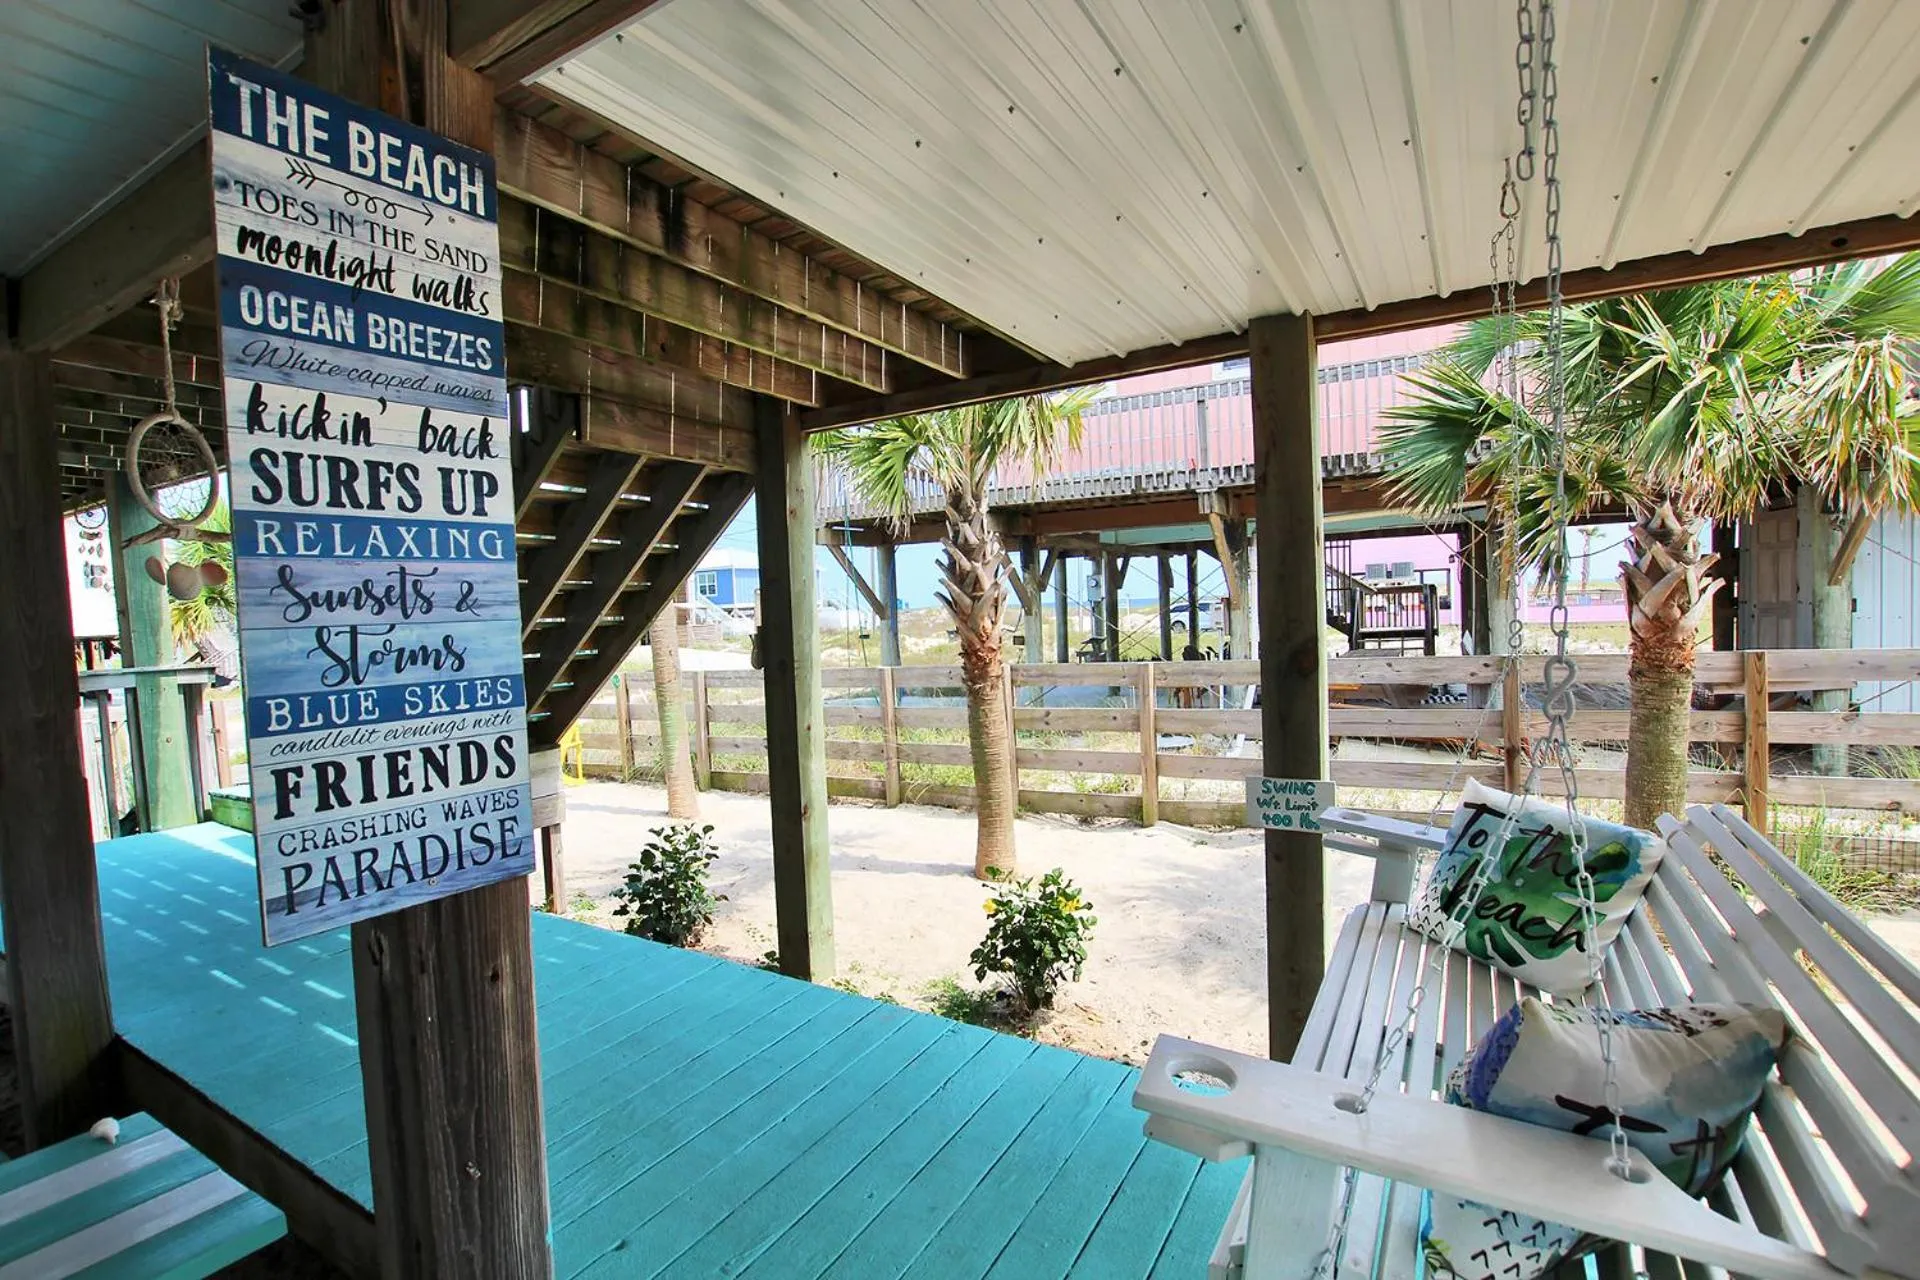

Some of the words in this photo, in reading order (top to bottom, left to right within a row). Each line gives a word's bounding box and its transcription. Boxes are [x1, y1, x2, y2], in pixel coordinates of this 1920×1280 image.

[229, 72, 330, 164] THE
[348, 120, 485, 215] BEACH
[234, 180, 319, 226] TOES
[328, 208, 355, 237] IN
[365, 220, 416, 254] THE
[425, 239, 488, 274] SAND
[237, 225, 396, 302] moonlight
[412, 273, 490, 316] walks
[240, 285, 355, 344] OCEAN
[367, 312, 492, 371] BREEZES
[347, 365, 431, 392] capped
[434, 381, 494, 401] waves
[418, 407, 499, 460] back
[250, 447, 422, 513] SURFS
[437, 467, 499, 516] UP
[254, 520, 504, 560] RELAXING
[269, 564, 439, 623] Sunsets
[455, 580, 480, 617] &
[306, 623, 467, 687] Storms
[266, 690, 379, 732] BLUE
[404, 678, 513, 716] SKIES
[270, 727, 383, 757] candlelit
[383, 716, 468, 741] evenings
[472, 709, 513, 729] with
[270, 735, 516, 820] FRIENDS
[1261, 779, 1316, 796] SWING
[277, 807, 427, 857] CRASHING
[442, 789, 520, 822] WAVES
[1262, 812, 1293, 827] 400
[1449, 801, 1519, 856] To
[281, 816, 523, 916] PARADISE
